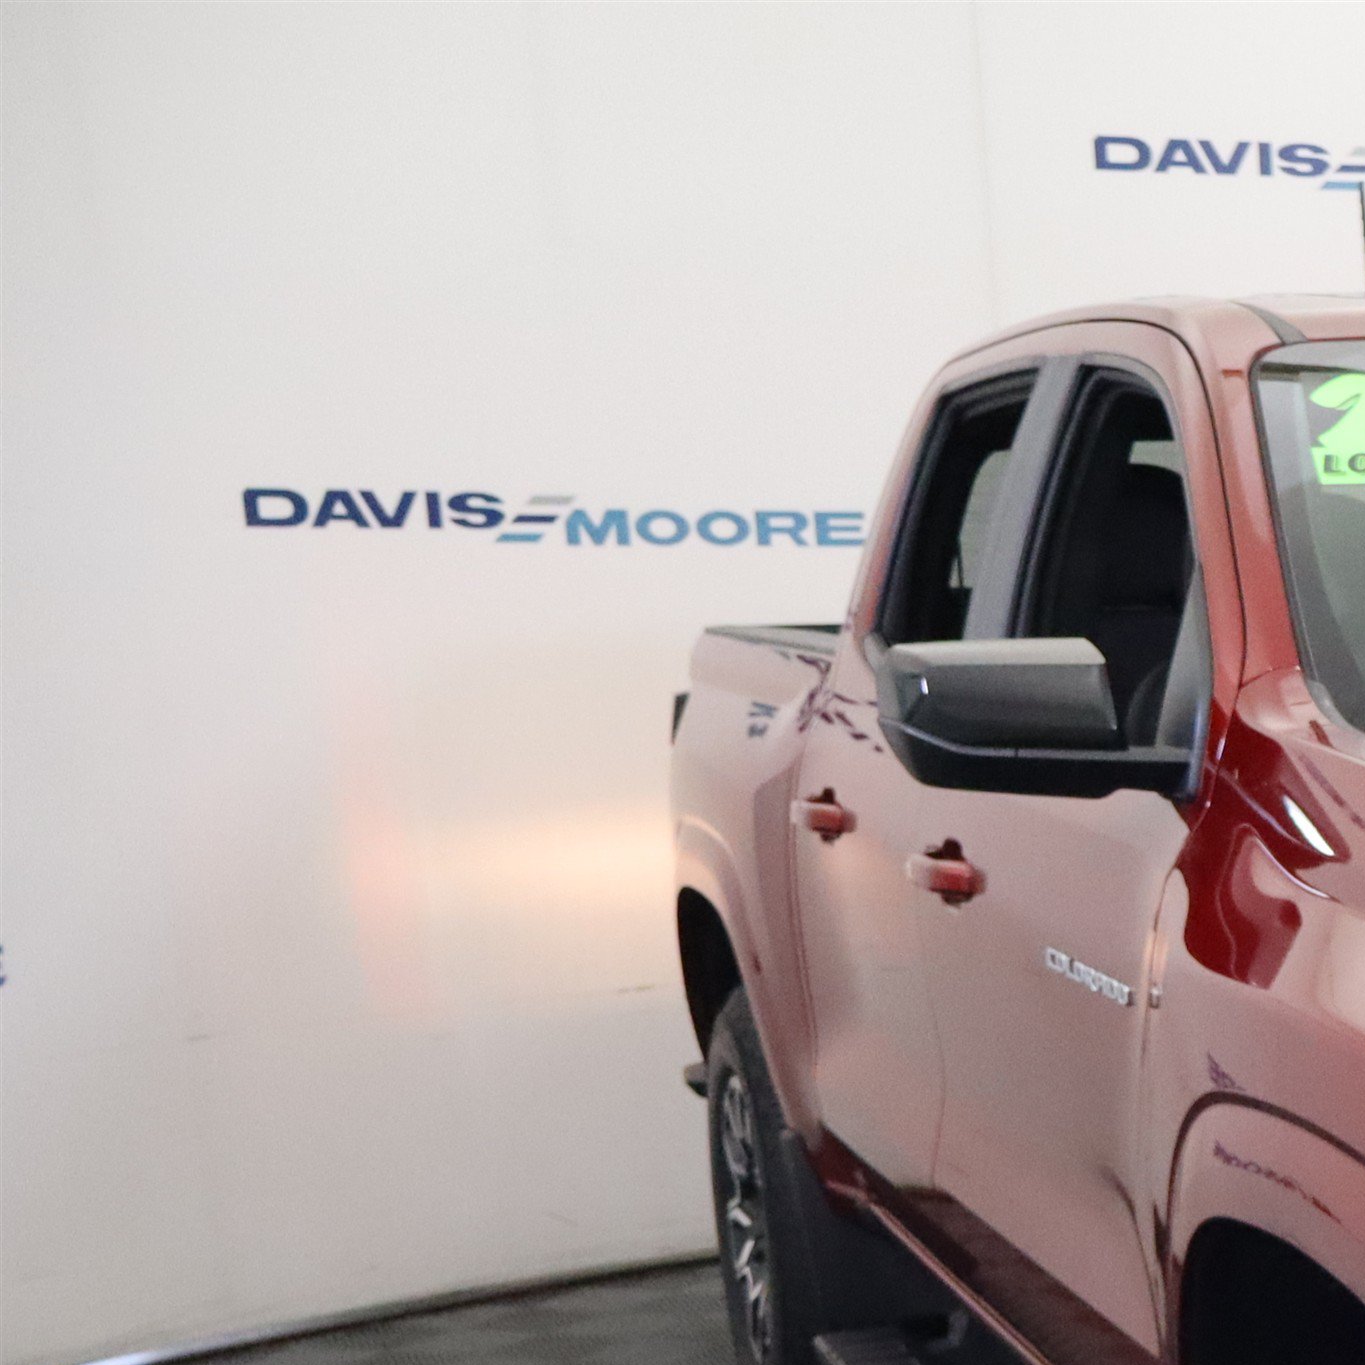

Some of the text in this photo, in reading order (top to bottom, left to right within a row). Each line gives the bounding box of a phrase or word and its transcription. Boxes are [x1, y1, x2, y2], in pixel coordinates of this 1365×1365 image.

[1094, 136, 1330, 176] DAVIS
[242, 488, 865, 546] DAVIS MOORE
